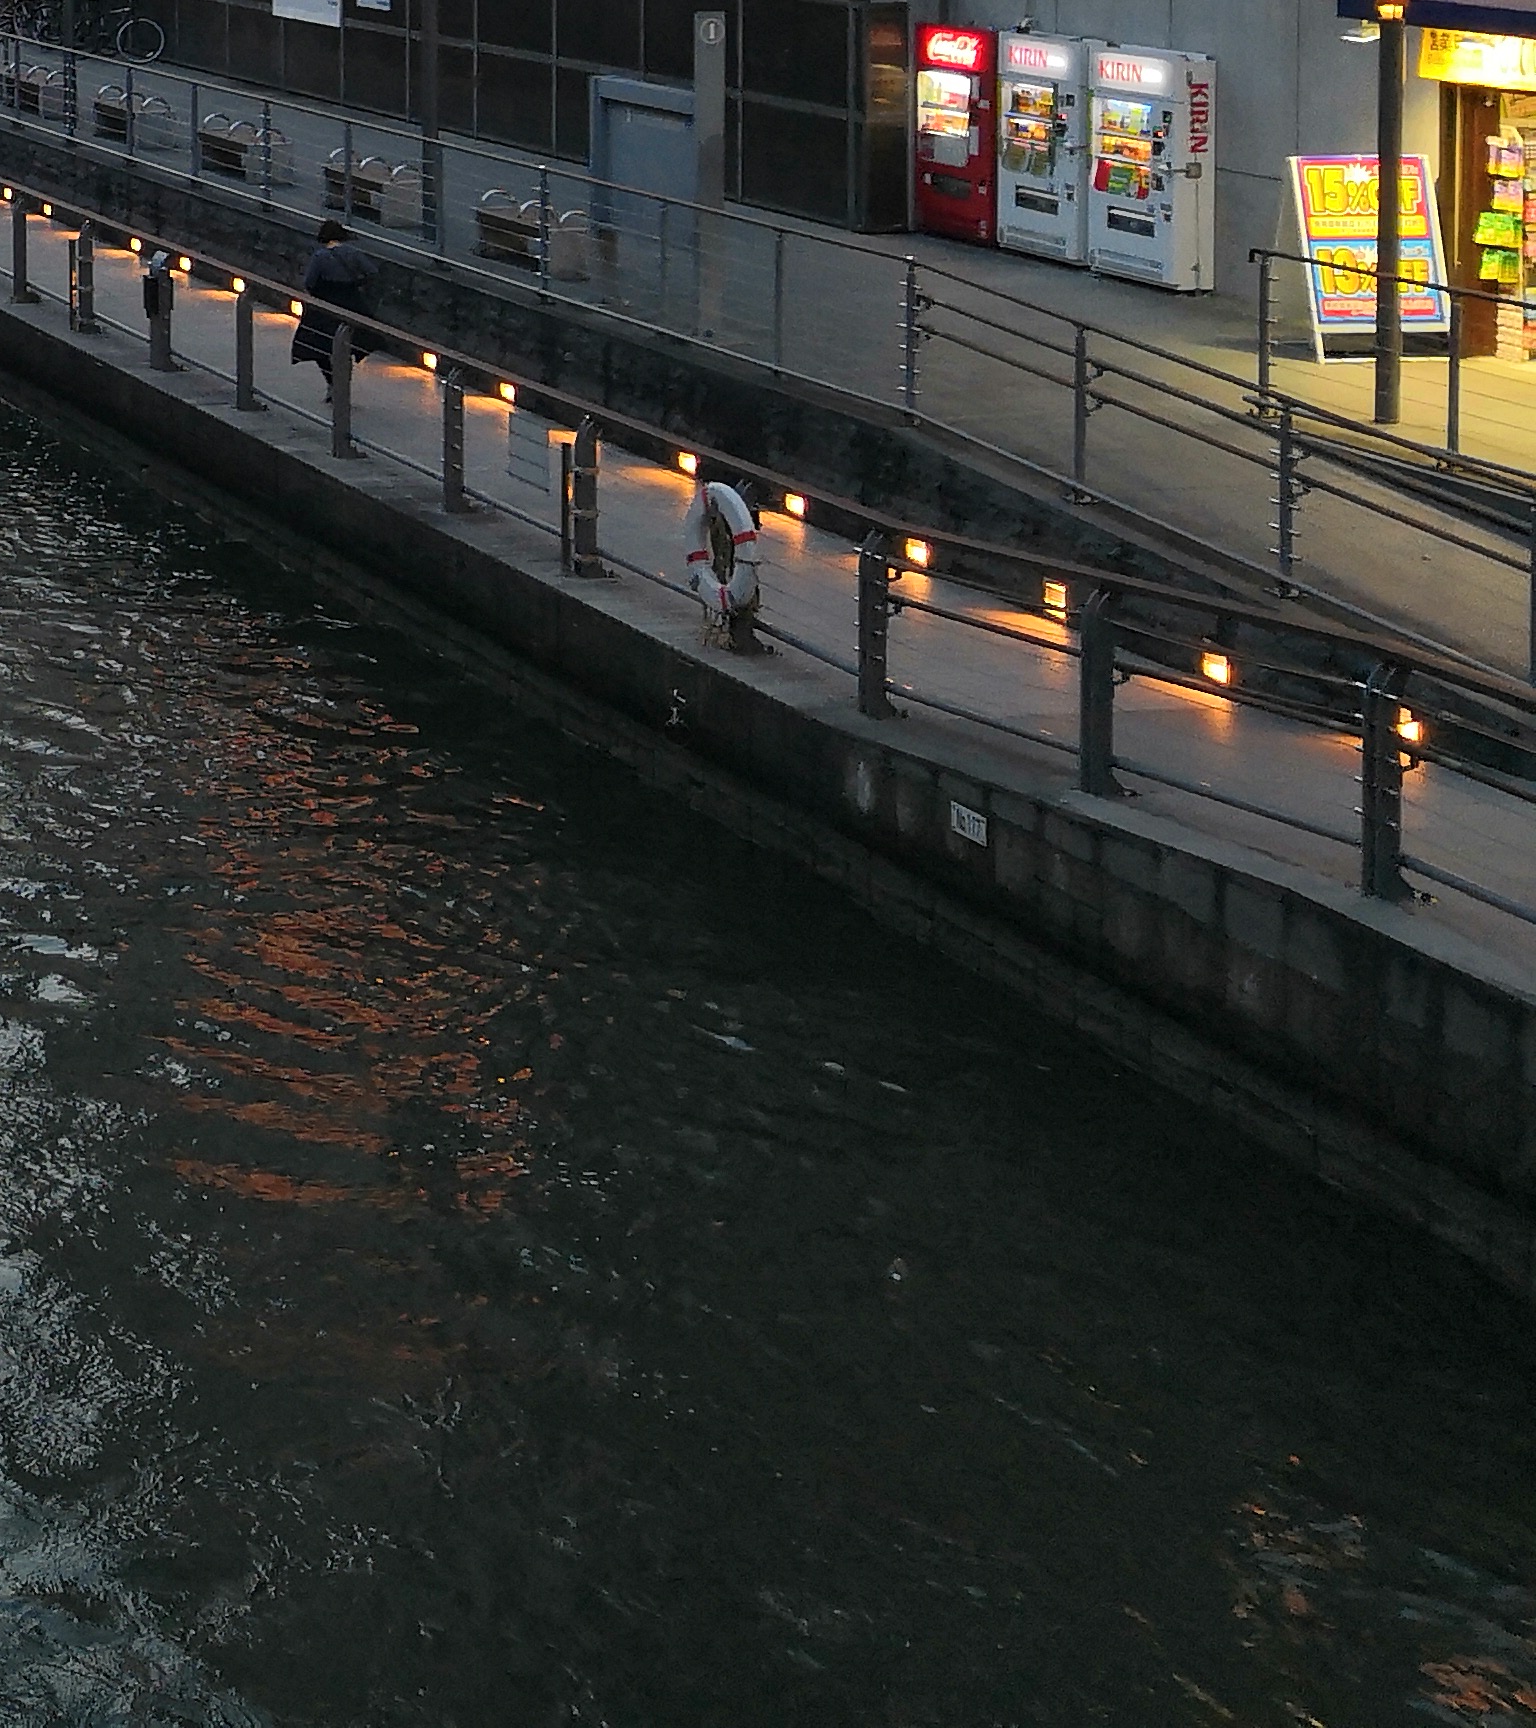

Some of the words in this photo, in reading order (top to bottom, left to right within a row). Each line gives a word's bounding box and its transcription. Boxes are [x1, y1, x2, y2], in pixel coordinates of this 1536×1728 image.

[1009, 46, 1048, 69] KIRIN
[1098, 59, 1143, 84] KIRIN
[1188, 81, 1209, 154] KIRIN
